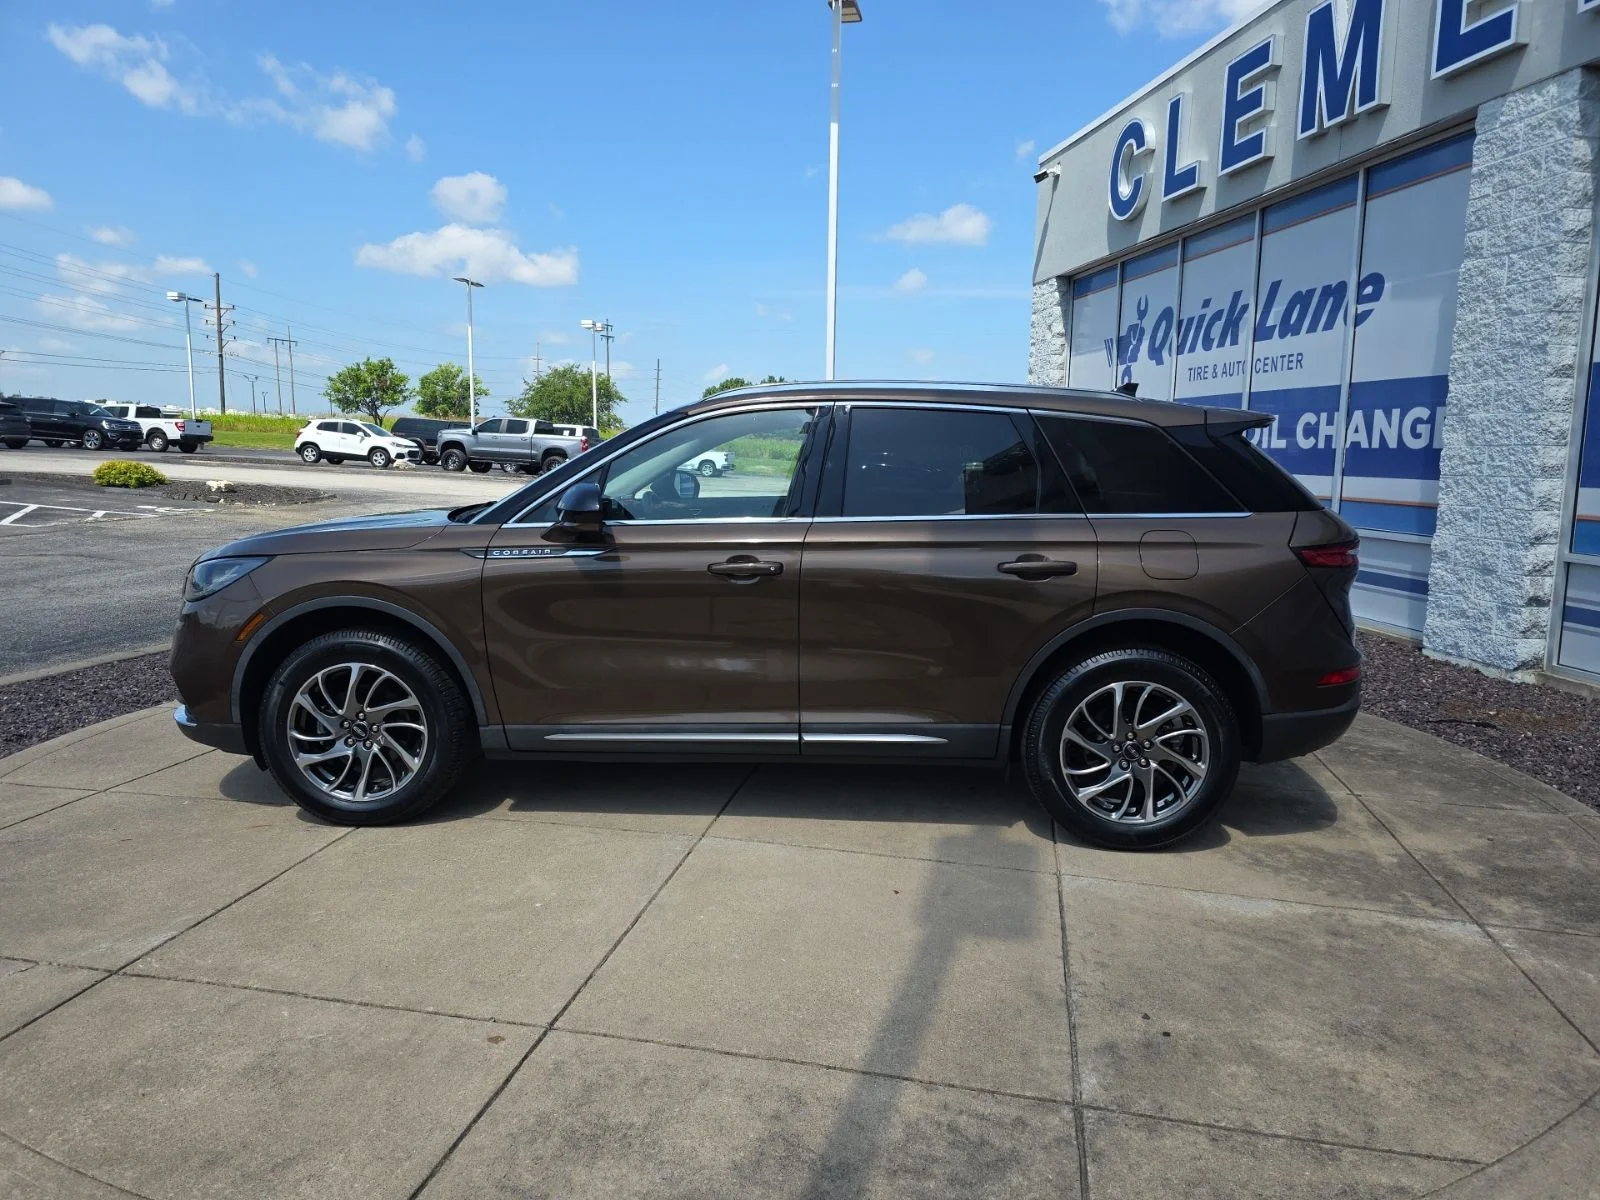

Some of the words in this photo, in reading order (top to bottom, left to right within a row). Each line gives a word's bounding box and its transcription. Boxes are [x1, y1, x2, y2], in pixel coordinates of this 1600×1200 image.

[1147, 290, 1250, 366] Quick
[1254, 272, 1385, 343] Lane
[1188, 365, 1208, 382] TIRE
[1211, 363, 1218, 379] &
[1254, 352, 1304, 375] CENTER
